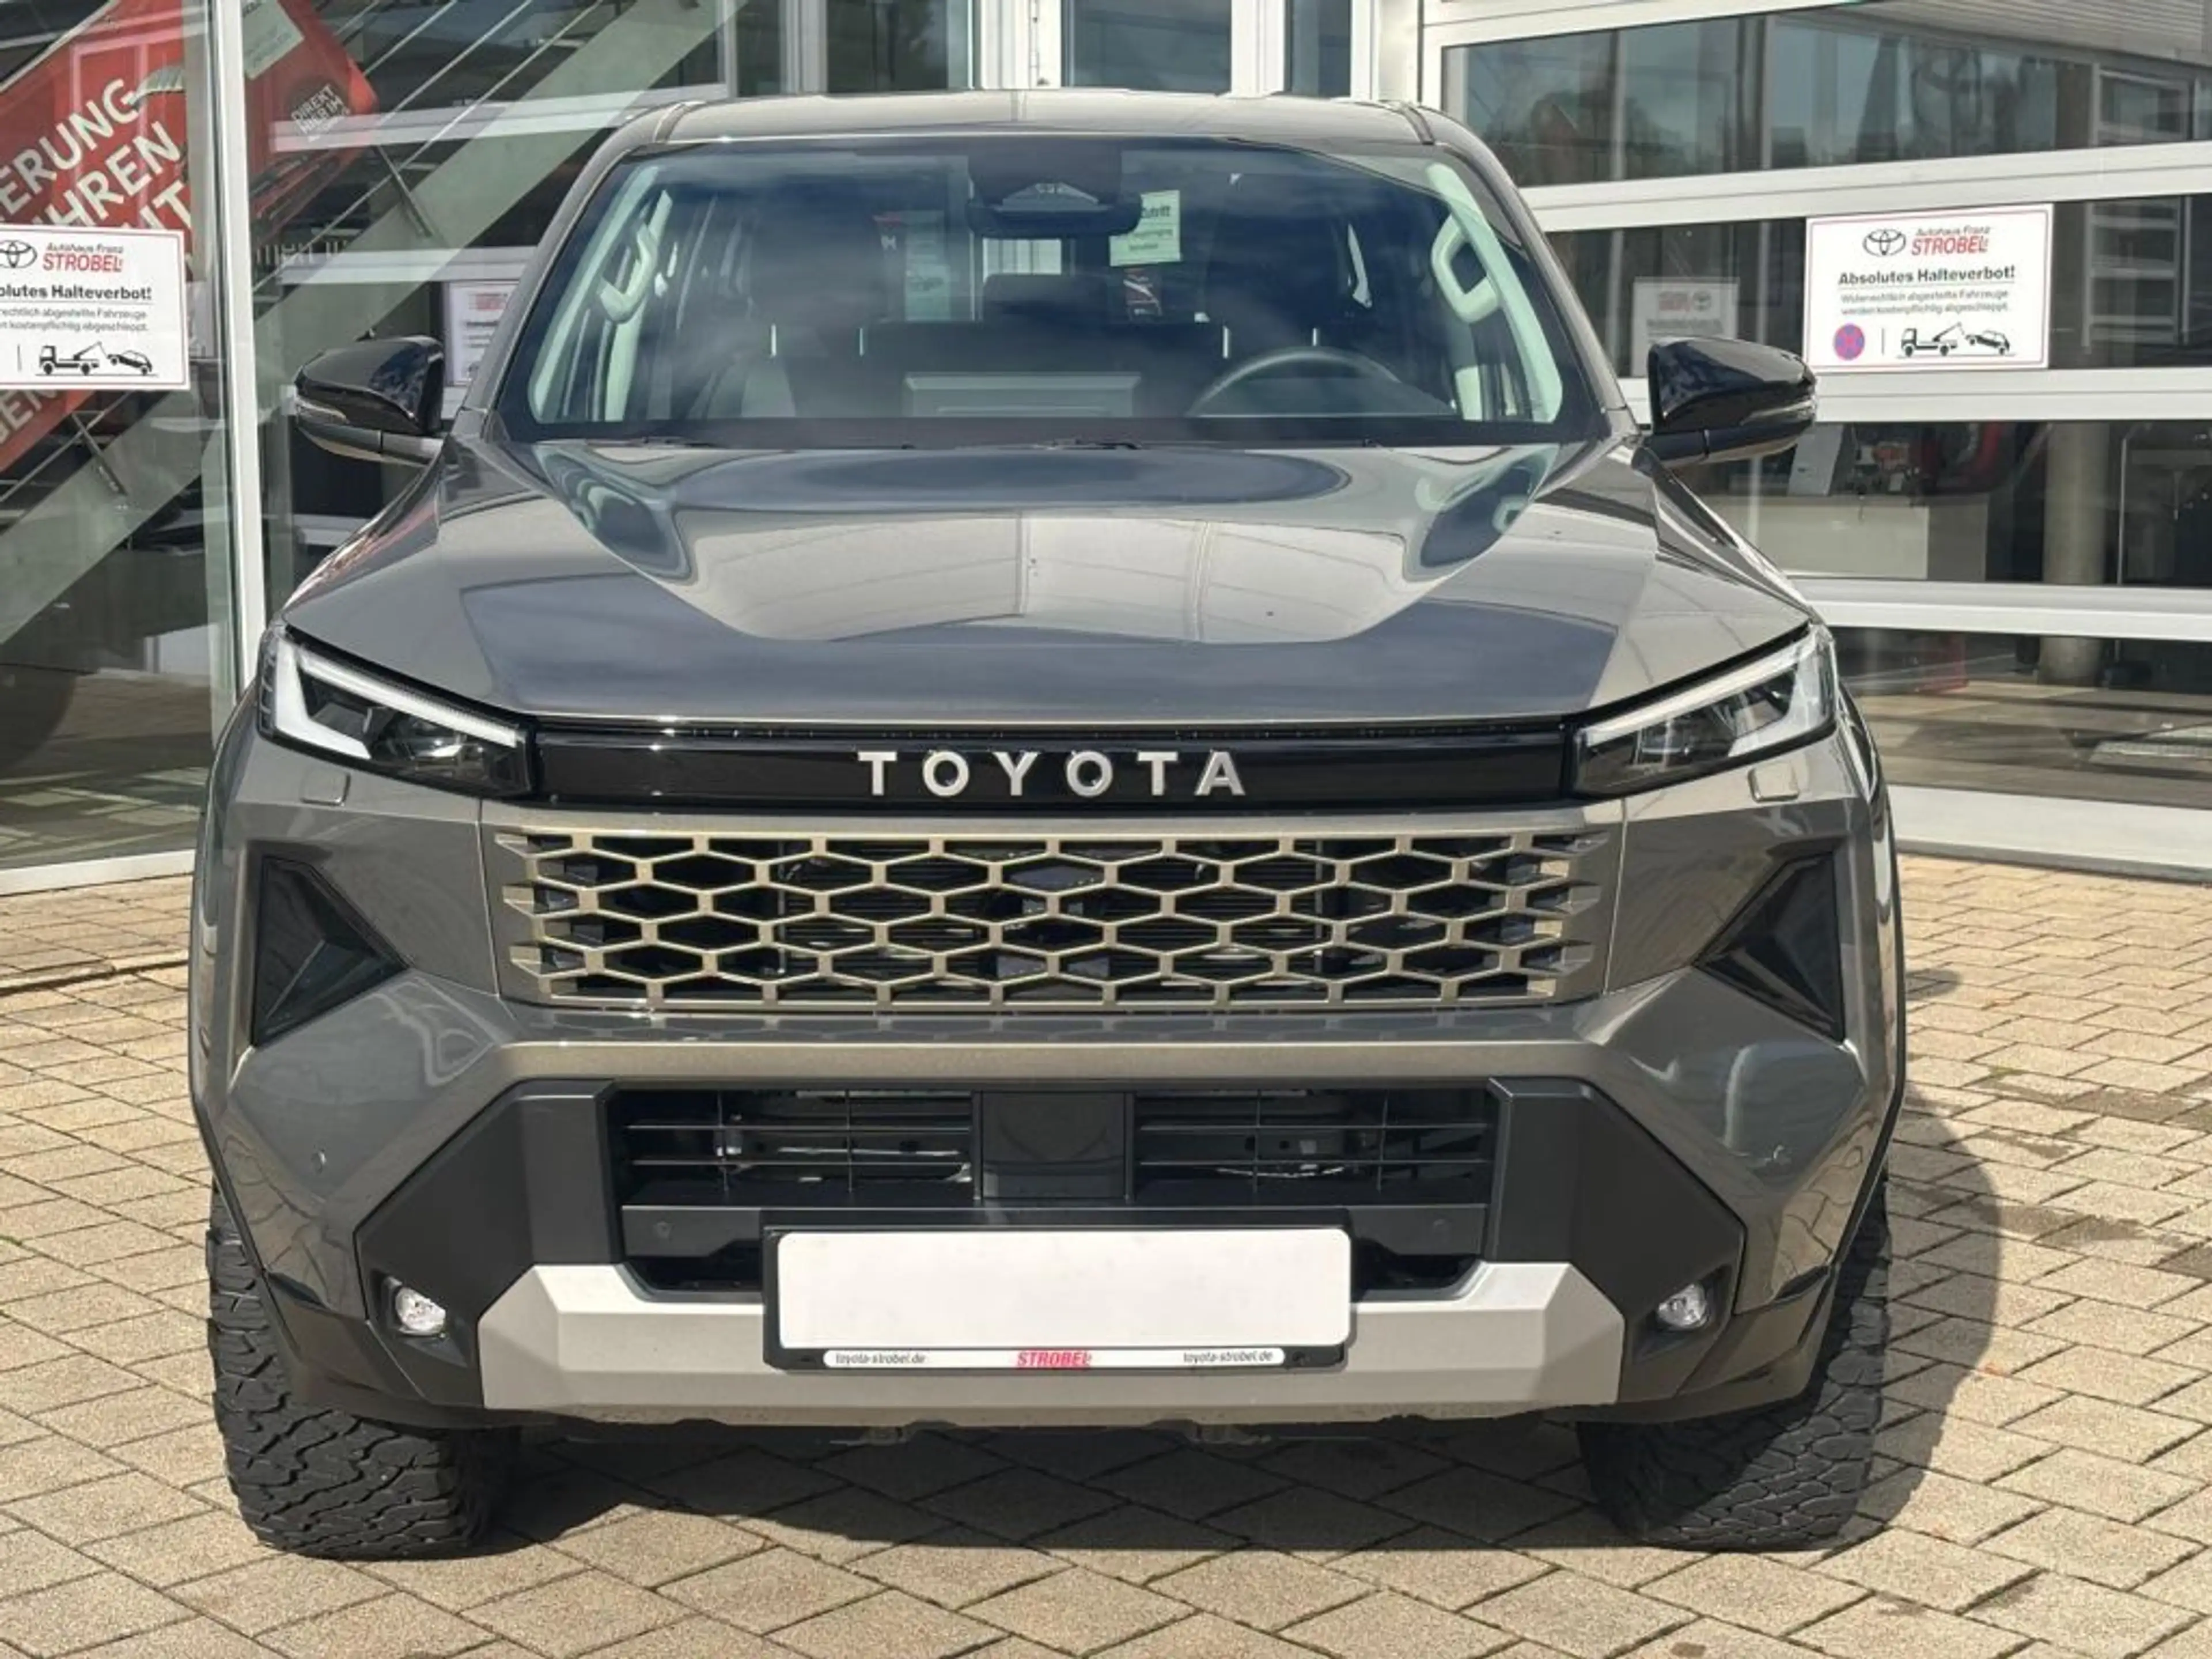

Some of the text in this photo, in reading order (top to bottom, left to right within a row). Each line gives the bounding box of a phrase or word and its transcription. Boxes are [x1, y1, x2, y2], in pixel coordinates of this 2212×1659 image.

[32, 121, 180, 225] HREN
[1916, 225, 1991, 236] Autohaus Franz
[47, 242, 124, 253] Autohaus Franz
[1838, 264, 2016, 285] Absolutes Halteverbot!
[51, 284, 153, 300] Halteverbot!
[857, 748, 1245, 798] TOYOTA
[835, 1352, 926, 1366] toyota-strobel.de
[1183, 1350, 1274, 1364] toyota-strobel.de
